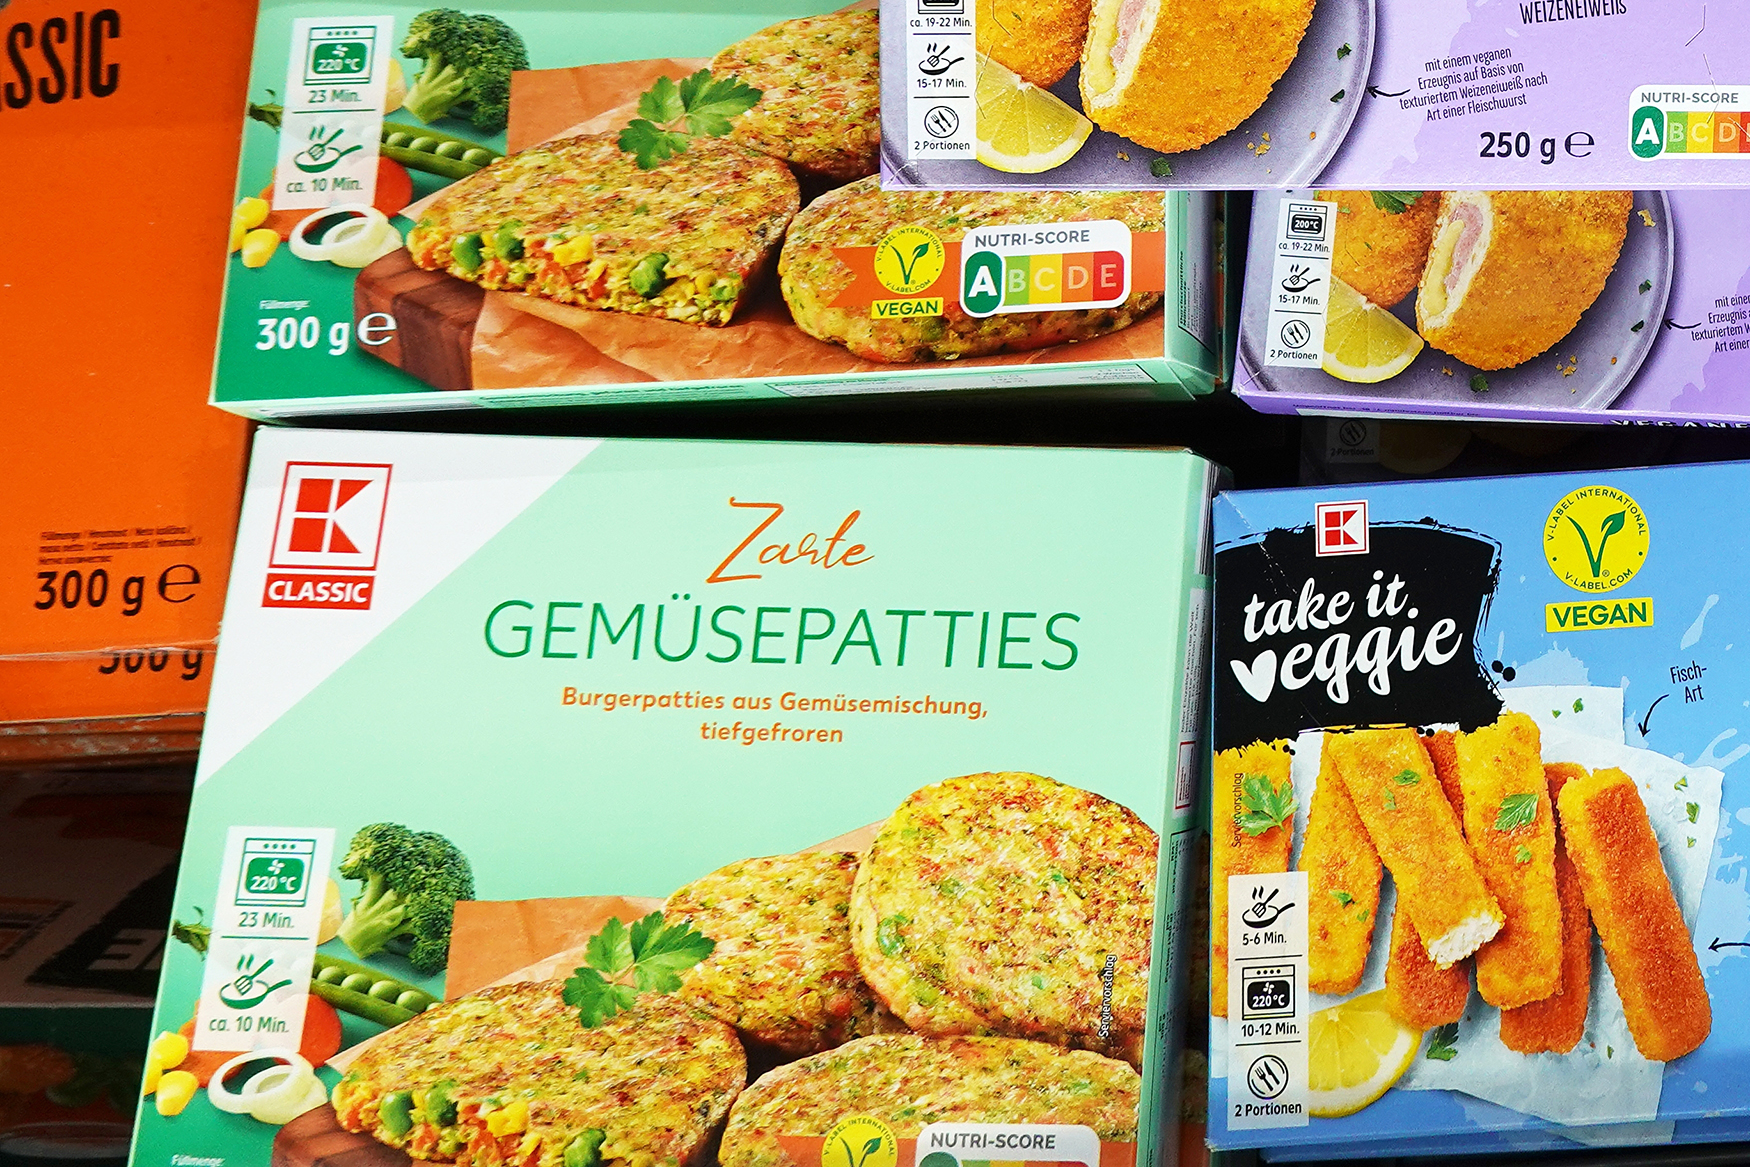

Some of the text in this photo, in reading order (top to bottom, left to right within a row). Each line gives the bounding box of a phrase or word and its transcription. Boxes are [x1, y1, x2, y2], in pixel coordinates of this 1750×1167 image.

[910, 17, 973, 27] ca. 19-22 Min.
[917, 78, 967, 88] 15-17 Min.
[1399, 71, 1548, 112] texturiertem Weizeneiweiß nach
[309, 88, 328, 104] 23
[1640, 91, 1738, 104] NUTRI-SCORE
[923, 140, 970, 150] Portionen
[1479, 132, 1557, 165] 250 g
[974, 230, 1089, 248] NUTRI-SCORE
[876, 300, 938, 317] VEGAN
[257, 315, 321, 350] 300
[705, 497, 875, 584] Zarte
[35, 569, 108, 611] 300
[269, 581, 369, 604] CLASSIC
[1243, 577, 1355, 642] take
[483, 593, 1081, 672] GEMÜSEPATTIES
[1670, 663, 1707, 685] Fisch-
[561, 688, 988, 720] Burgerpatties aus Gemüsemischung,
[1685, 686, 1704, 704] Art
[700, 721, 844, 745] tiefgefroren
[239, 912, 294, 929] 23 Min.
[1101, 954, 1116, 1038] Serviervorschlag
[209, 1017, 252, 1033] ca. 10
[1242, 1022, 1301, 1038] 10-12 Min.
[1246, 1101, 1302, 1117] Portionen
